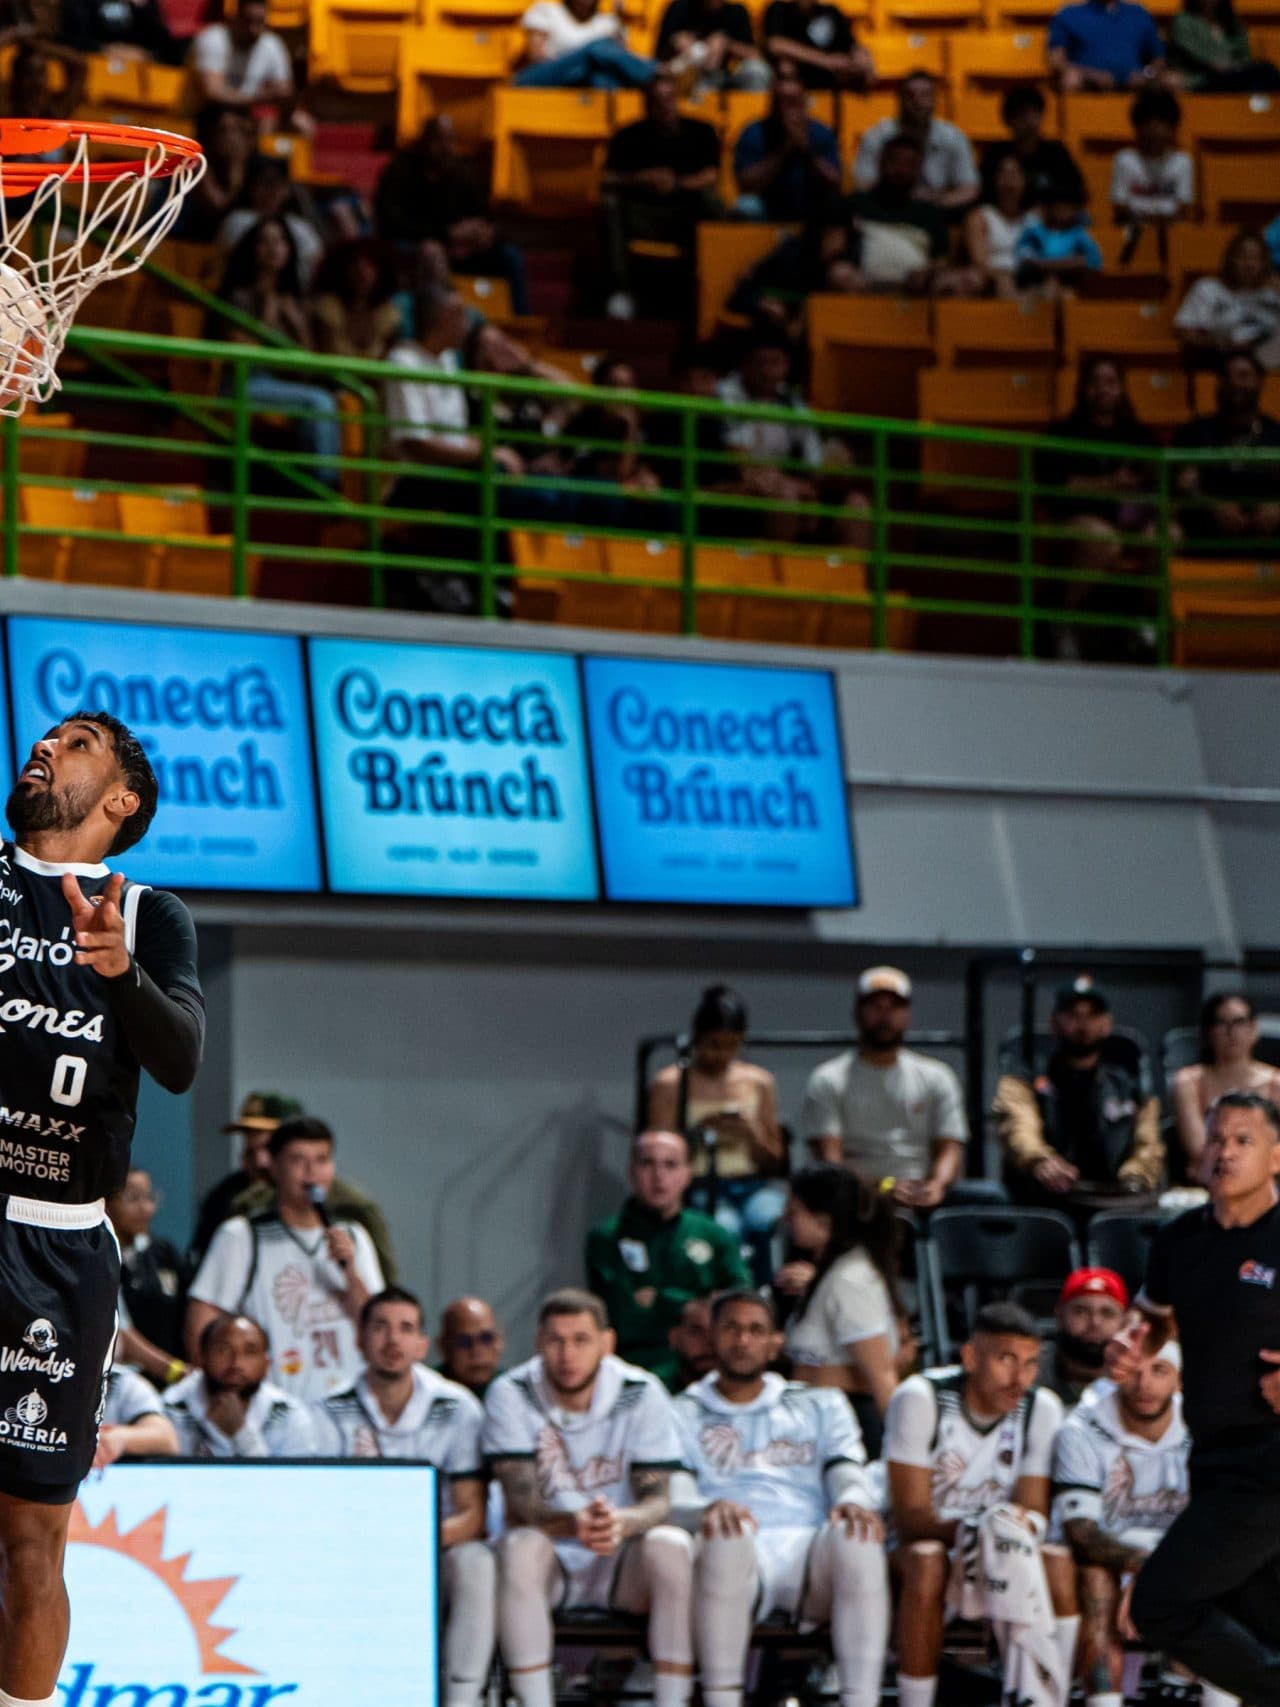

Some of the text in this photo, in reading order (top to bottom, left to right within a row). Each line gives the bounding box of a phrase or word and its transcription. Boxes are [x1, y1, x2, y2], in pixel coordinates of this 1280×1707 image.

[36, 648, 286, 732] Conecta
[333, 667, 565, 748] Conecta
[607, 686, 819, 759] Conecta
[349, 748, 563, 820] Brunch
[623, 763, 818, 829] Brunch
[50, 1054, 88, 1107] 0
[0, 1138, 70, 1167] MASTER
[0, 1346, 76, 1384] Wendy's
[7, 1438, 36, 1450] PUERTO
